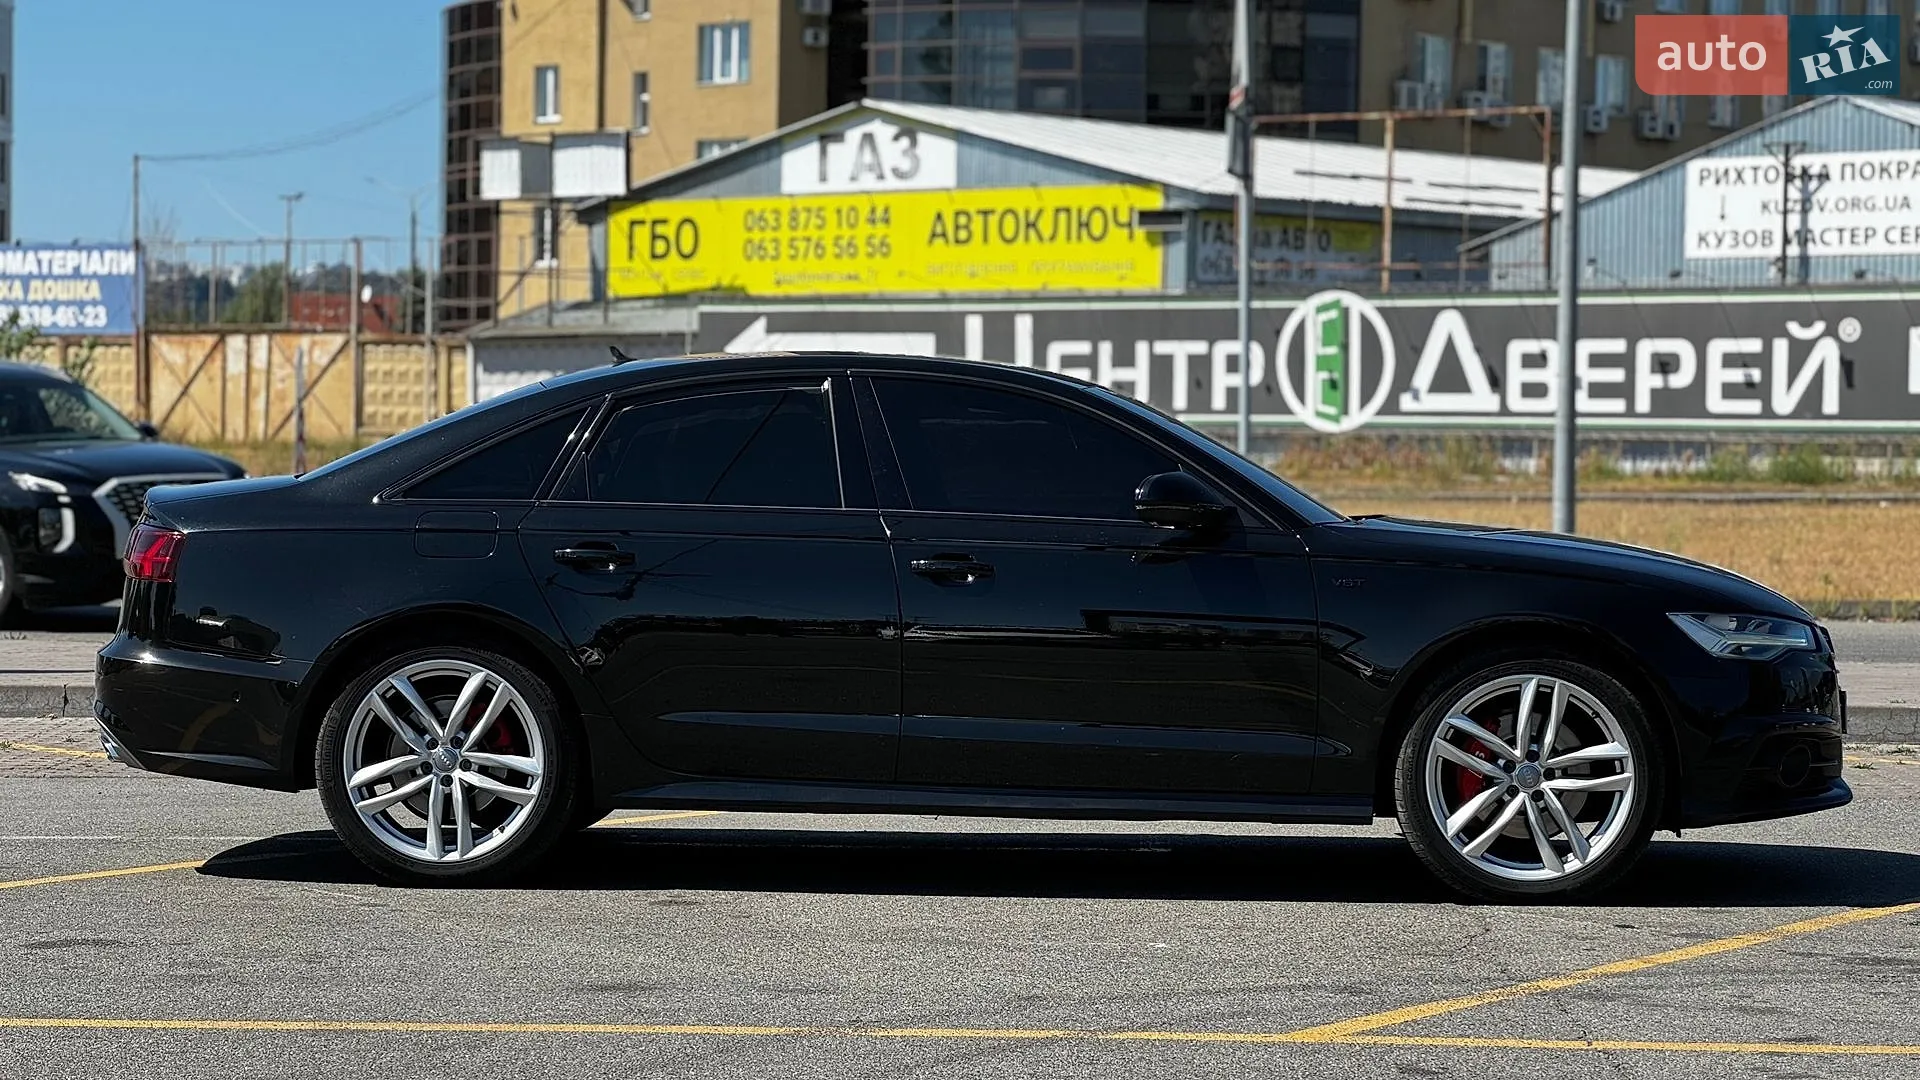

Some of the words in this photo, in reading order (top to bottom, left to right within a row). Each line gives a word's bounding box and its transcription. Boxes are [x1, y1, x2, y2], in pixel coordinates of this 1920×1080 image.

[818, 127, 921, 184] ГАЗ
[743, 208, 781, 232] 063
[788, 205, 827, 231] 875
[835, 205, 859, 230] 10
[866, 204, 891, 229] 44
[928, 204, 1135, 247] АВТОКЛЮЧ
[627, 216, 701, 262] ГБО
[743, 237, 781, 262] 063
[788, 236, 827, 261] 576
[833, 234, 859, 260] 56
[865, 233, 891, 259] 56
[1697, 228, 1774, 249] КУЗОВ
[27, 278, 101, 302] ДОШКА
